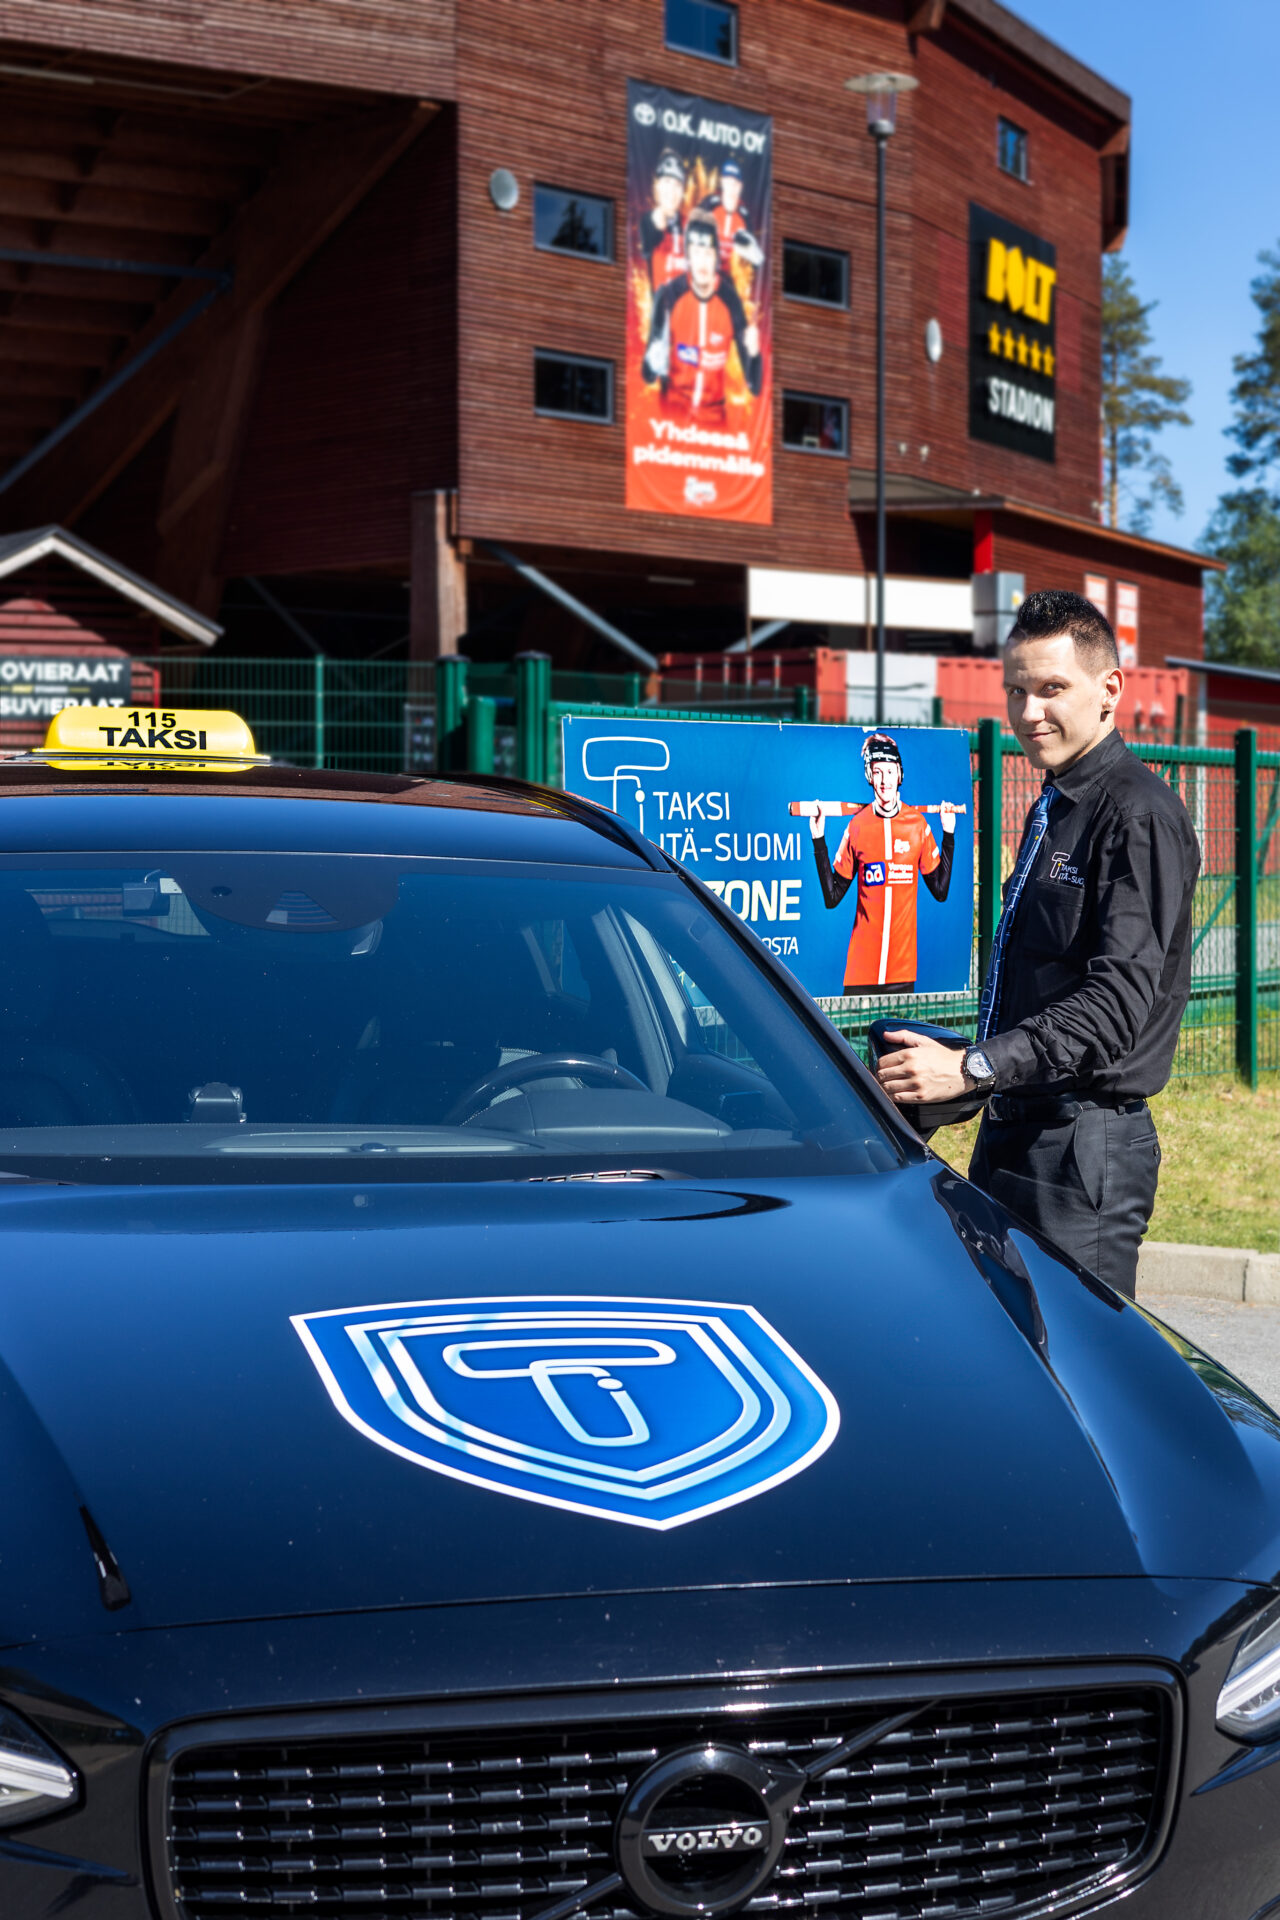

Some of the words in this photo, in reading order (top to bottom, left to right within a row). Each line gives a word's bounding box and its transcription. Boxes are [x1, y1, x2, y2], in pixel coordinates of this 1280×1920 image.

[698, 118, 741, 148] AUTO
[743, 129, 766, 154] OY
[989, 377, 1054, 433] STADION
[128, 711, 176, 728] 115
[99, 726, 207, 750] TAKSI
[653, 791, 730, 821] TAKSI
[660, 828, 801, 862] ITÄ-SUOMI
[1061, 863, 1078, 874] TAKSI
[648, 1827, 763, 1852] VOLVO
